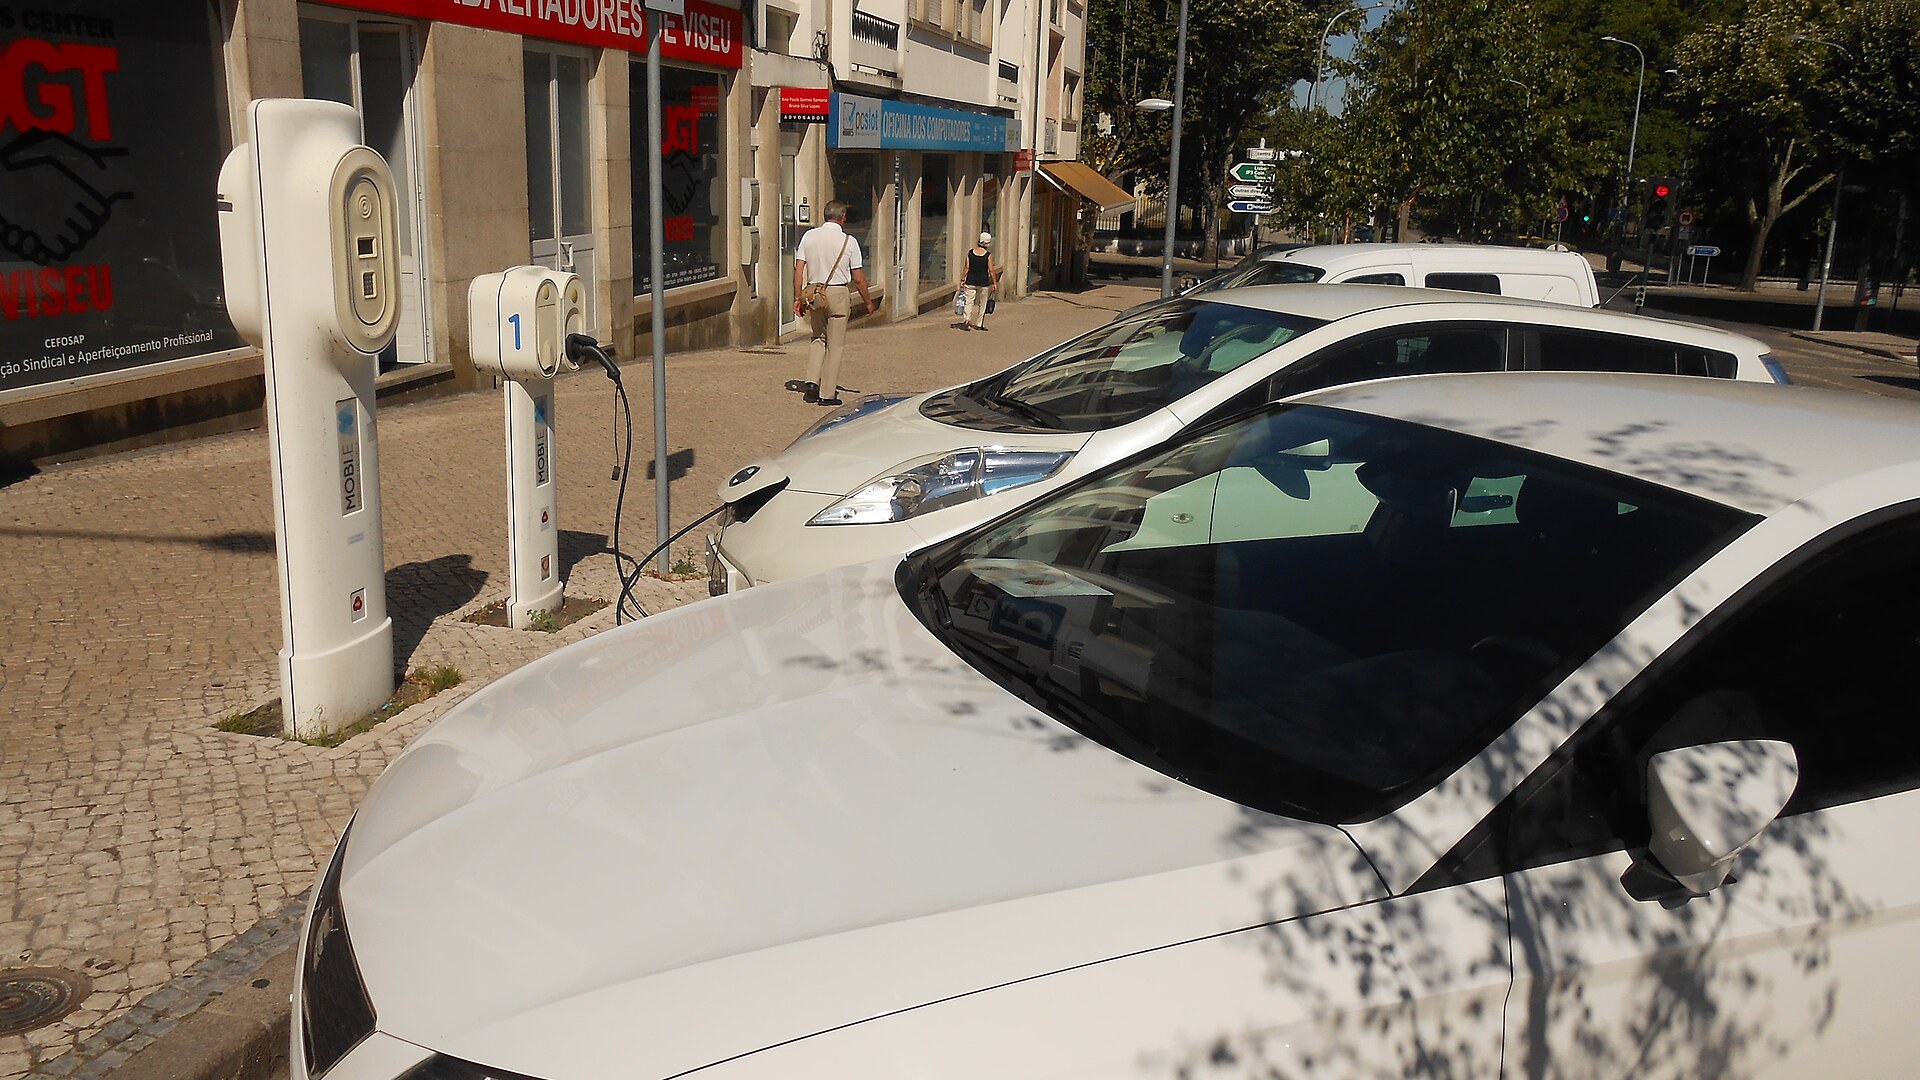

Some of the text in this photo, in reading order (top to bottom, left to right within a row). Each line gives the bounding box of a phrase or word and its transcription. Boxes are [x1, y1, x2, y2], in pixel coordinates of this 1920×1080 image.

[22, 8, 115, 39] CENTER
[683, 12, 731, 54] VISEU
[883, 111, 912, 139] OFICINA
[912, 115, 927, 140] DOS
[926, 117, 971, 142] COMPUTADORES
[0, 263, 113, 321] VISEU
[23, 353, 66, 372] Sindical
[68, 355, 76, 365] e
[77, 339, 162, 364] Aperfeiçoamento
[163, 328, 214, 348] Profissional
[44, 334, 86, 349] CEFOSAP
[508, 313, 521, 350] 1
